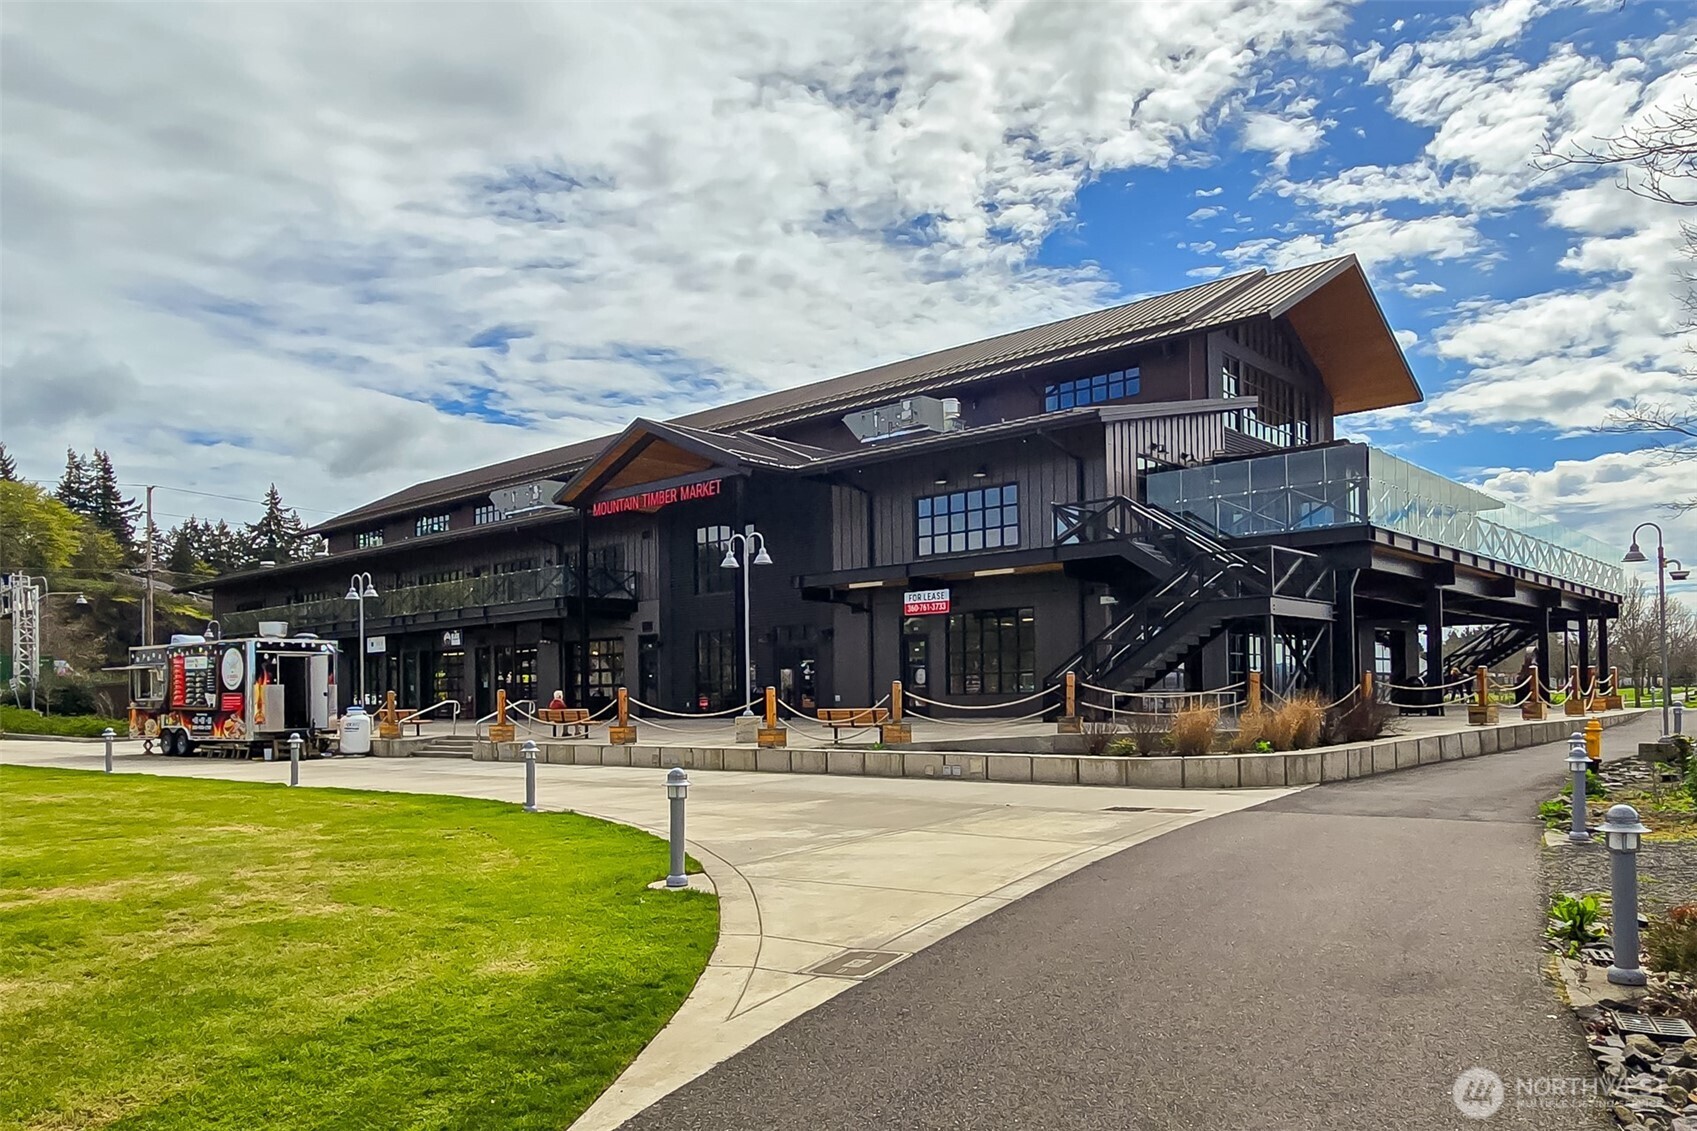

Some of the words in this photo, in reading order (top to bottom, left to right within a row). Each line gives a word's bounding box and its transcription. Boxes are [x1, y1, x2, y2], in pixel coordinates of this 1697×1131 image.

[593, 496, 639, 516] MOUNTAIN
[642, 488, 678, 507] TIMBER
[680, 480, 722, 501] MARKET
[908, 594, 922, 602] FOR
[923, 592, 945, 601] LEASE
[907, 602, 947, 613] 360-761-3733
